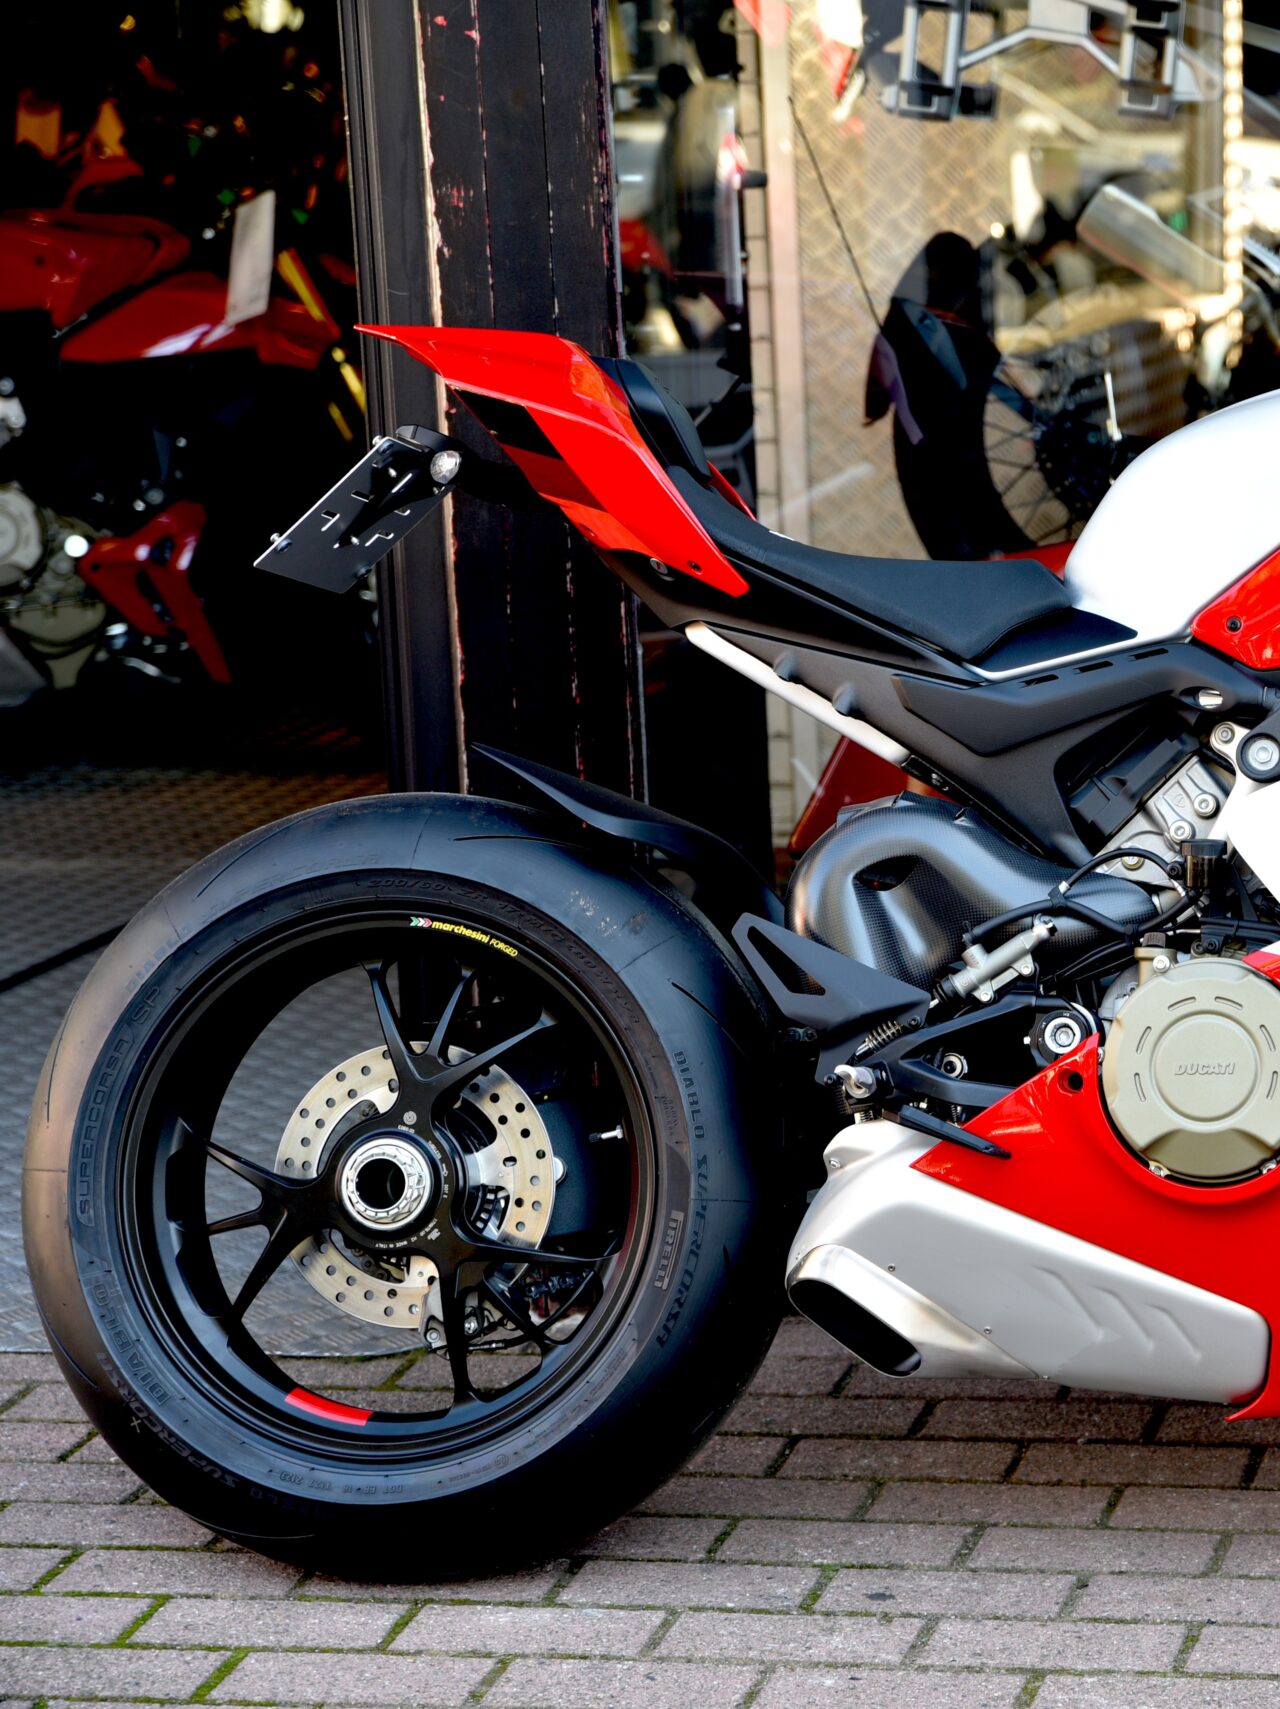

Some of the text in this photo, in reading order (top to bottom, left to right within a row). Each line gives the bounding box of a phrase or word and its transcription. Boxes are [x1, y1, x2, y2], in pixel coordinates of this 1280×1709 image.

[431, 921, 519, 957] marchesini FORGED
[78, 1036, 129, 1215] SUPERCORSA
[128, 983, 165, 1026] SP
[1174, 1062, 1236, 1076] DUCATI
[652, 1047, 709, 1349] DIABLO SUPERCORSA
[651, 1208, 686, 1292] PIRELLI
